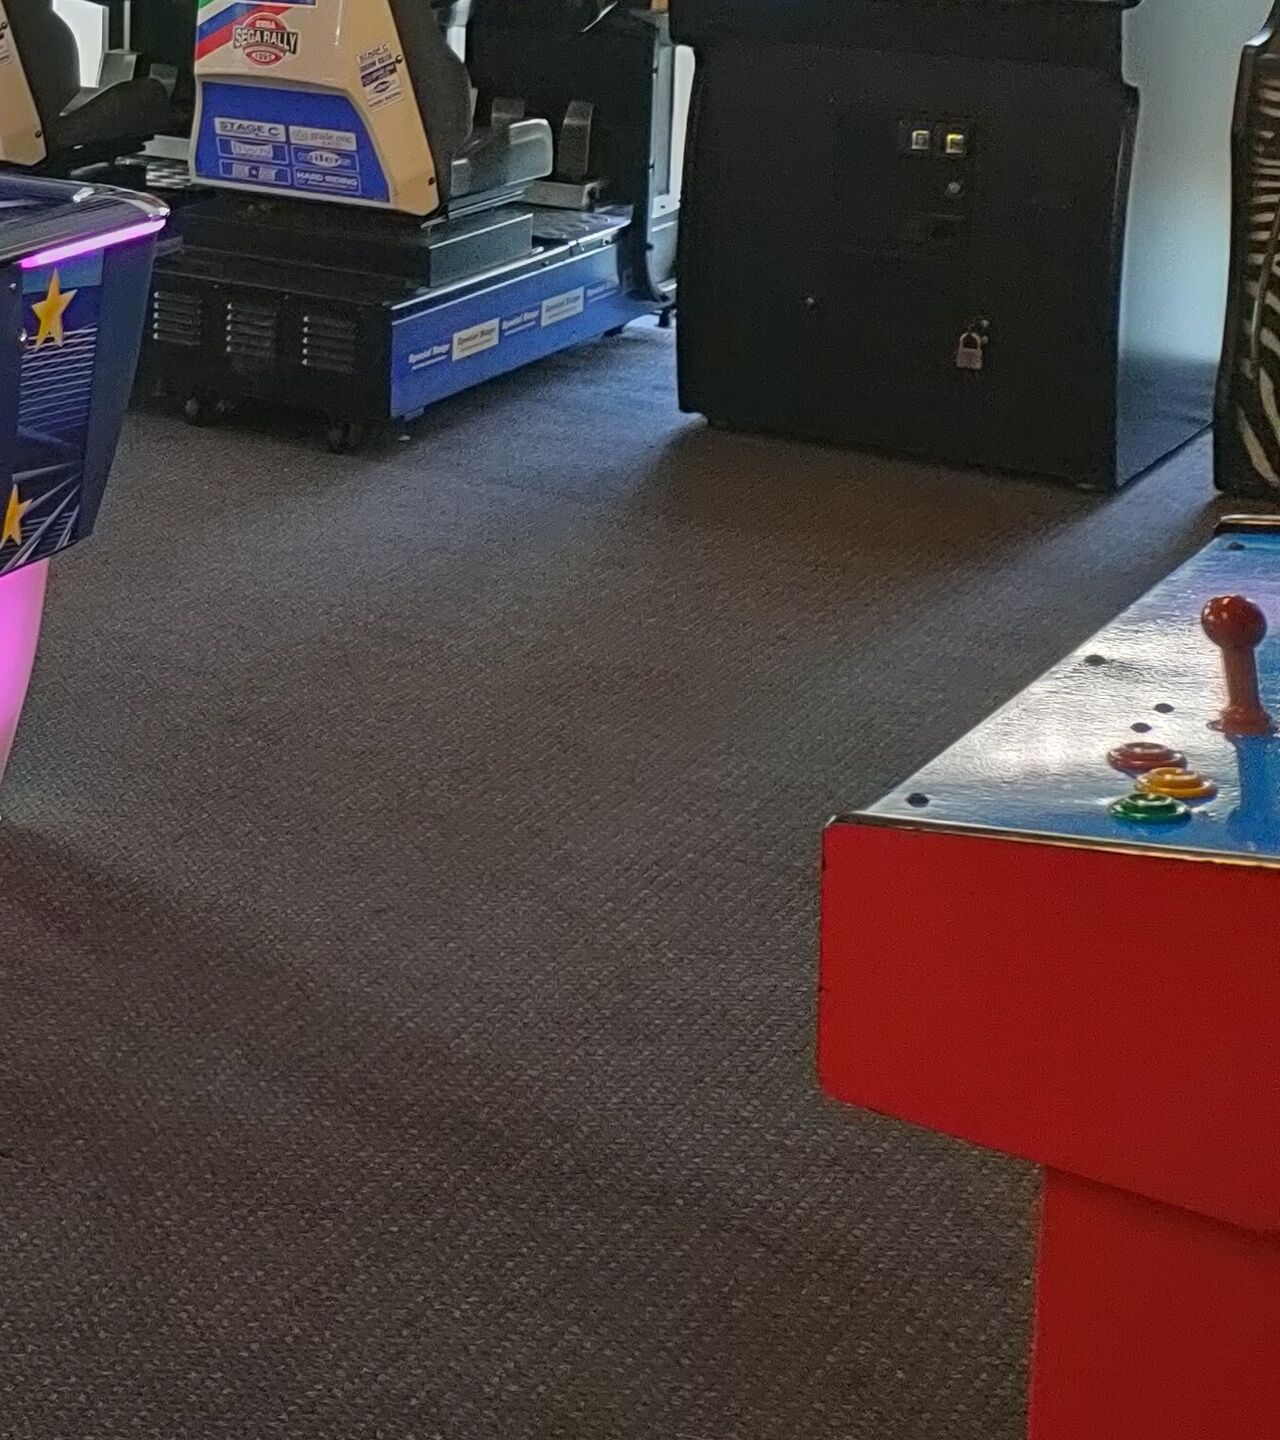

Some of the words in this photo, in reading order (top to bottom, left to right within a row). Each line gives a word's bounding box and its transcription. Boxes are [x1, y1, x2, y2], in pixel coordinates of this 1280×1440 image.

[234, 27, 261, 49] SEGA
[263, 28, 299, 54] RALLY
[219, 120, 265, 135] STAGE
[268, 126, 280, 137] C
